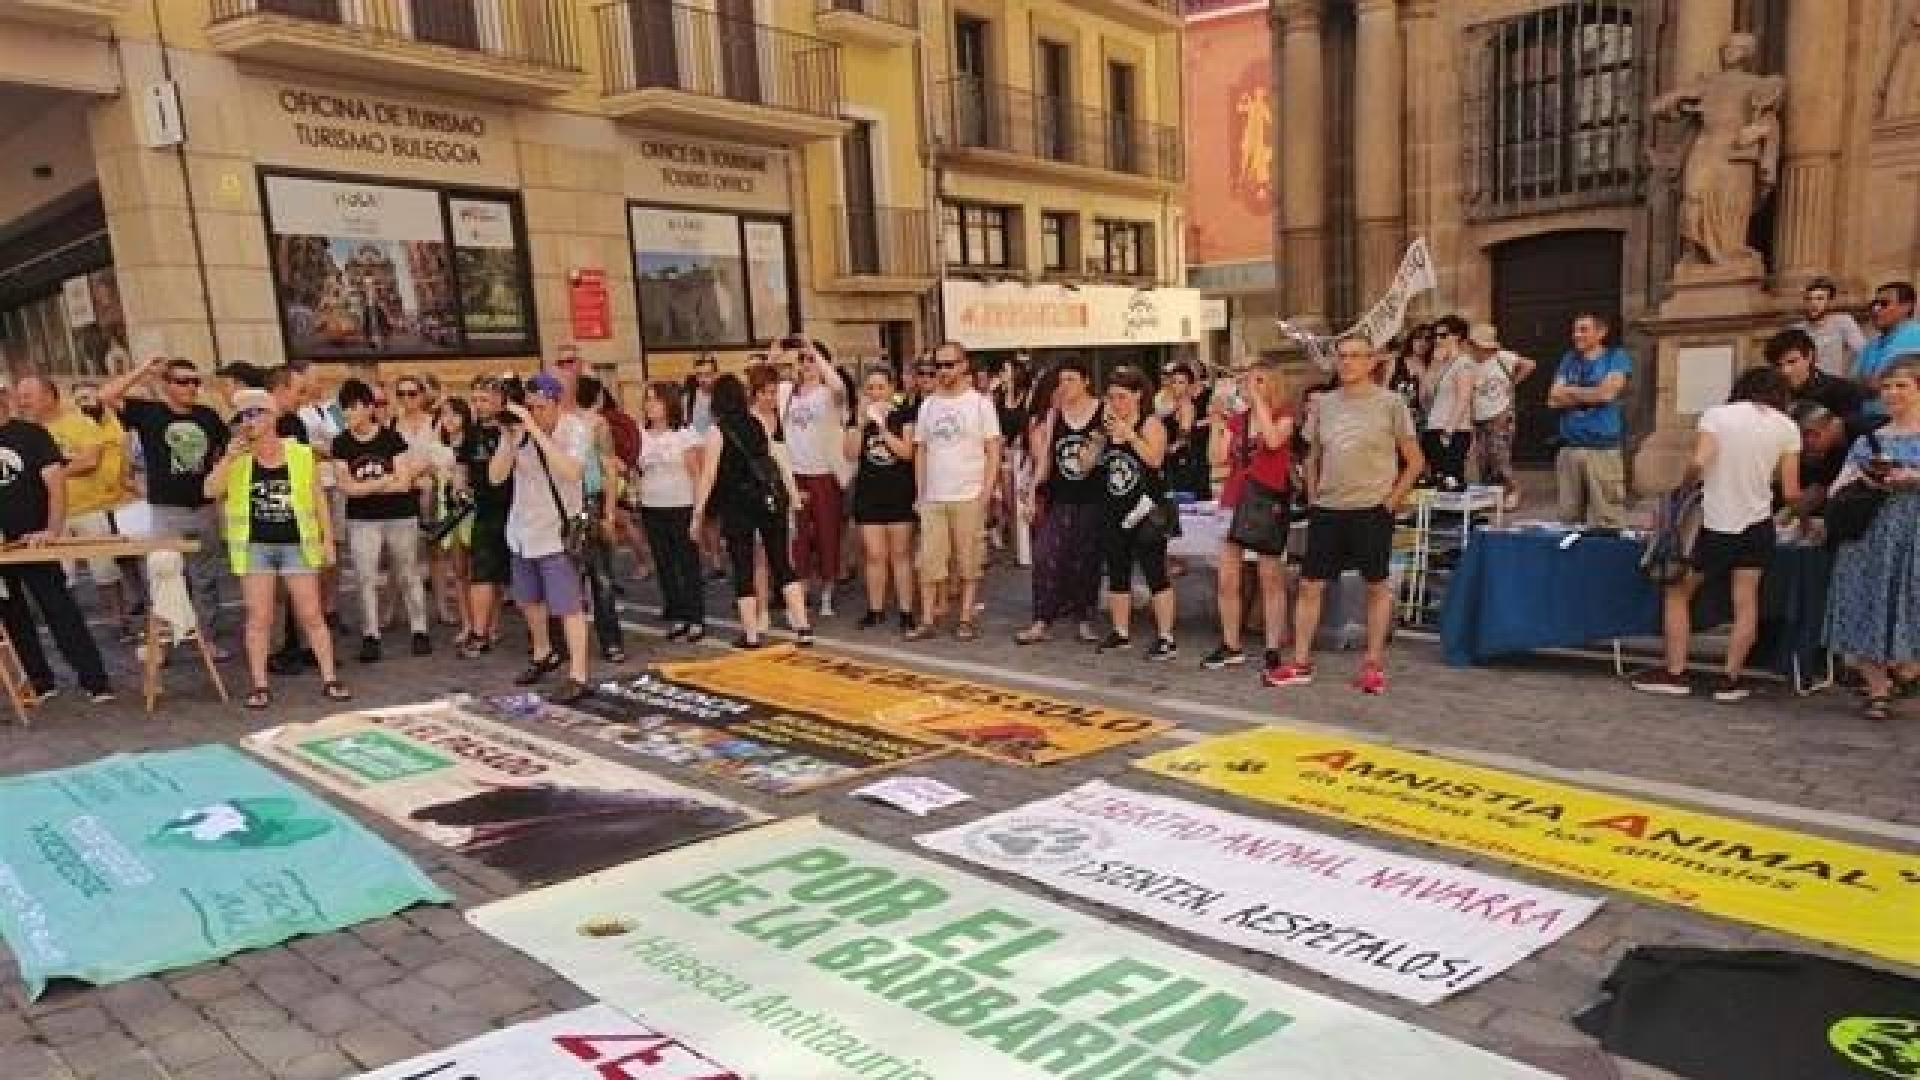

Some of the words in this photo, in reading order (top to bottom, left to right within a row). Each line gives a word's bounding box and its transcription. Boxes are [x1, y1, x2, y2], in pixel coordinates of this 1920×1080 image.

[279, 90, 370, 121] OFICINA
[374, 102, 402, 126] DE
[407, 107, 483, 137] TURISMO
[296, 122, 385, 154] TURISMO
[389, 135, 480, 165] BULEGOA
[1296, 749, 1564, 822] AMNISTIA
[1578, 815, 1879, 893] ANIMAL
[1221, 831, 1357, 879] ANIMAL
[1357, 866, 1564, 934] NAVARRA
[1611, 844, 1800, 891] animales
[660, 873, 773, 917] DE
[733, 905, 841, 949] LA
[626, 933, 753, 1003] Huesca
[733, 847, 952, 927] POR
[907, 908, 1063, 979] EL
[1037, 957, 1296, 1065] FIN
